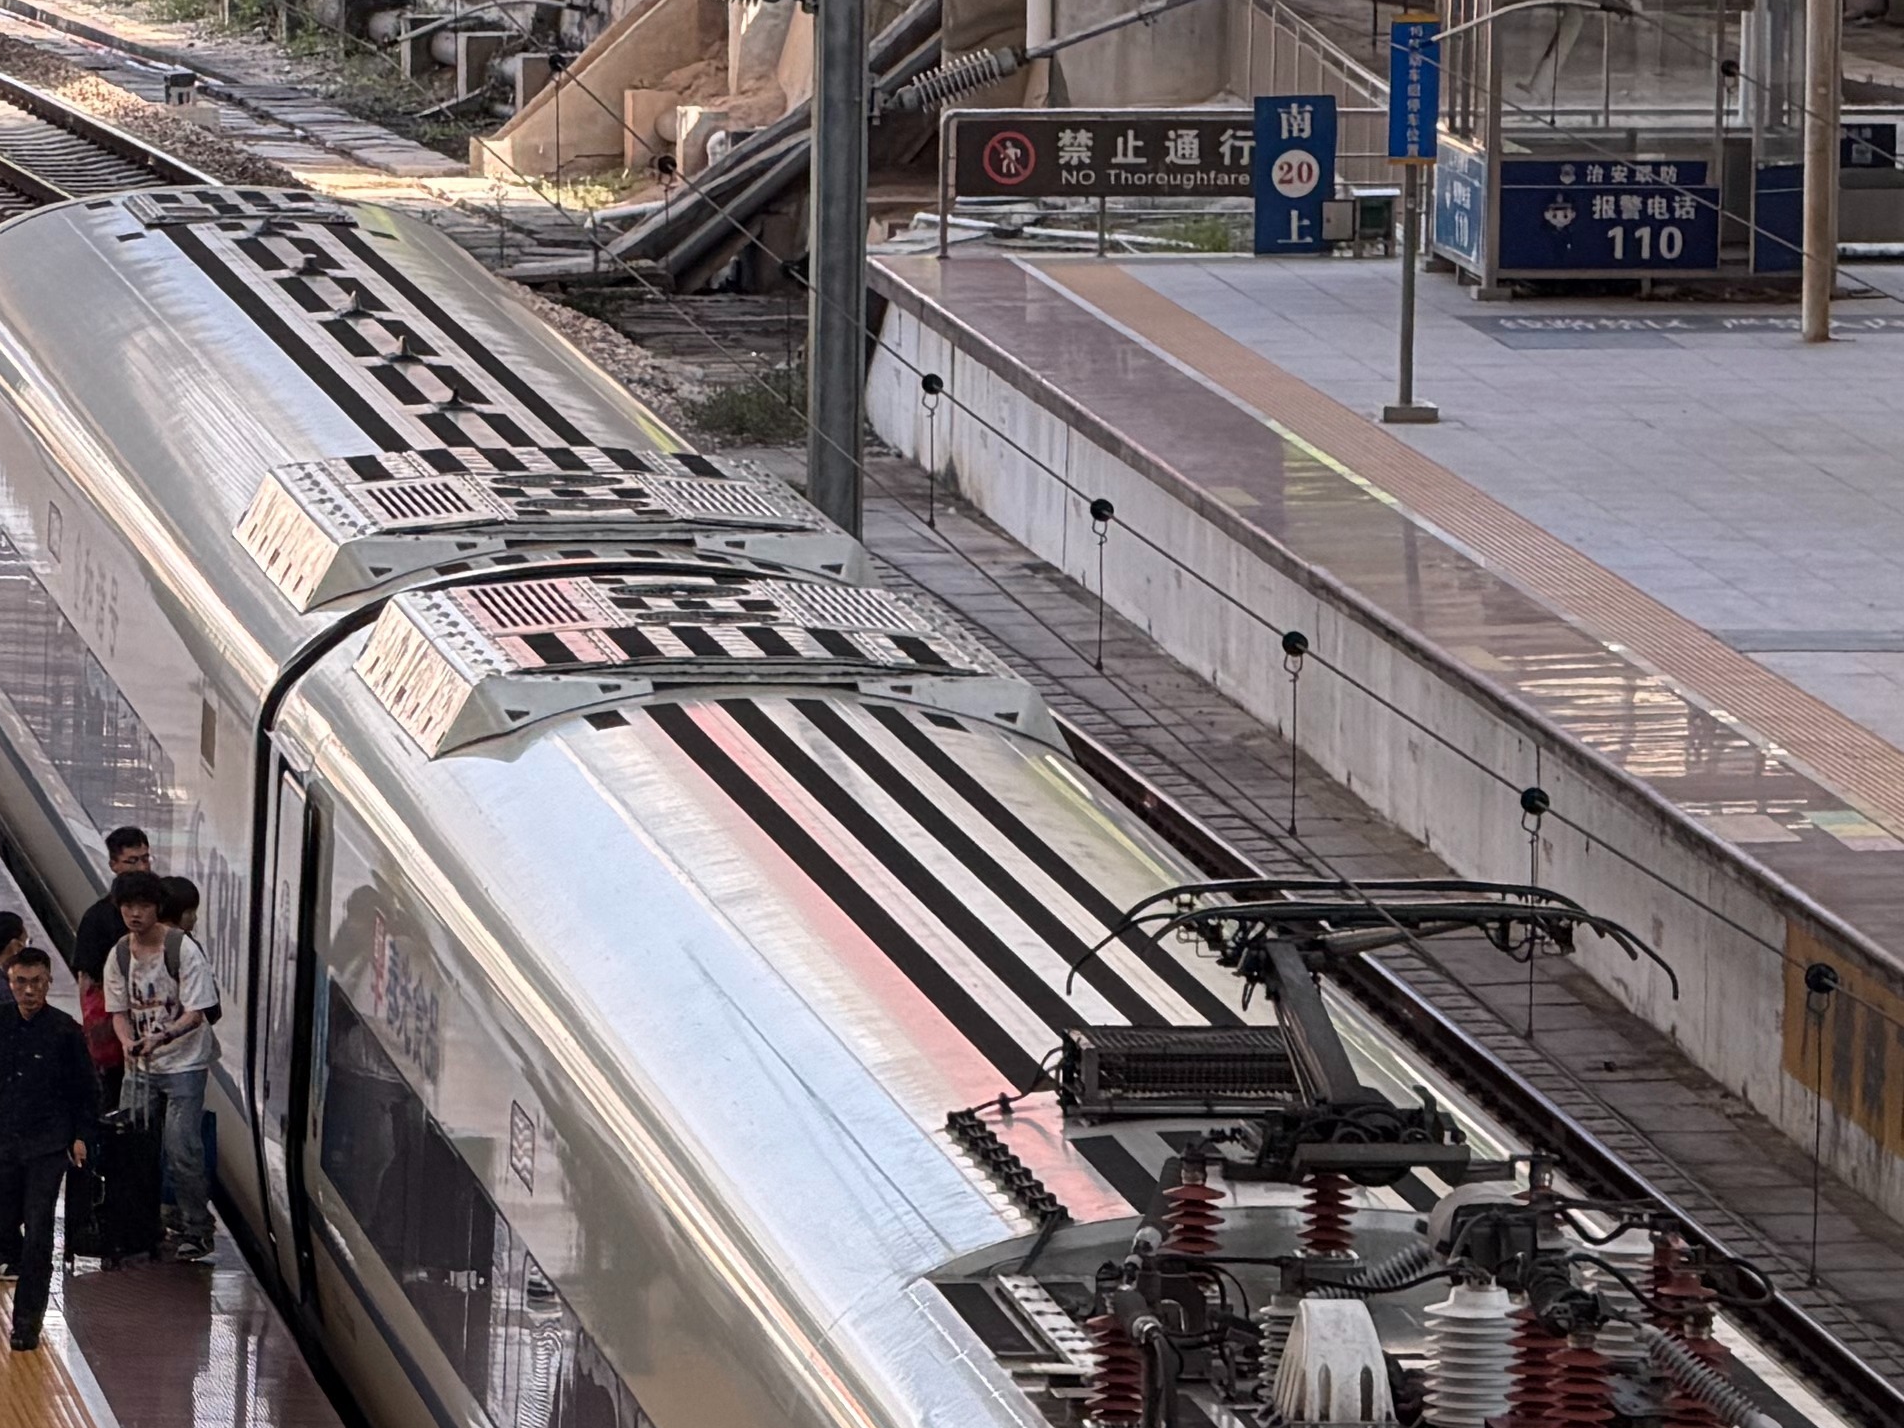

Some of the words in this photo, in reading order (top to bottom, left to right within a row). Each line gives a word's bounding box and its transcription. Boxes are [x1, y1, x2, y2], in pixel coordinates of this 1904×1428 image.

[1276, 103, 1314, 140] 南
[1057, 129, 1255, 167] 禁止通行
[1061, 170, 1096, 186] NO
[1106, 170, 1252, 189] Thoroughfare
[1276, 160, 1314, 185] 20
[1585, 164, 1678, 184] 治安联防
[1592, 194, 1697, 220] 报警电话
[1276, 209, 1314, 245] 上
[1607, 225, 1684, 260] 110
[205, 846, 243, 1005] CRH
